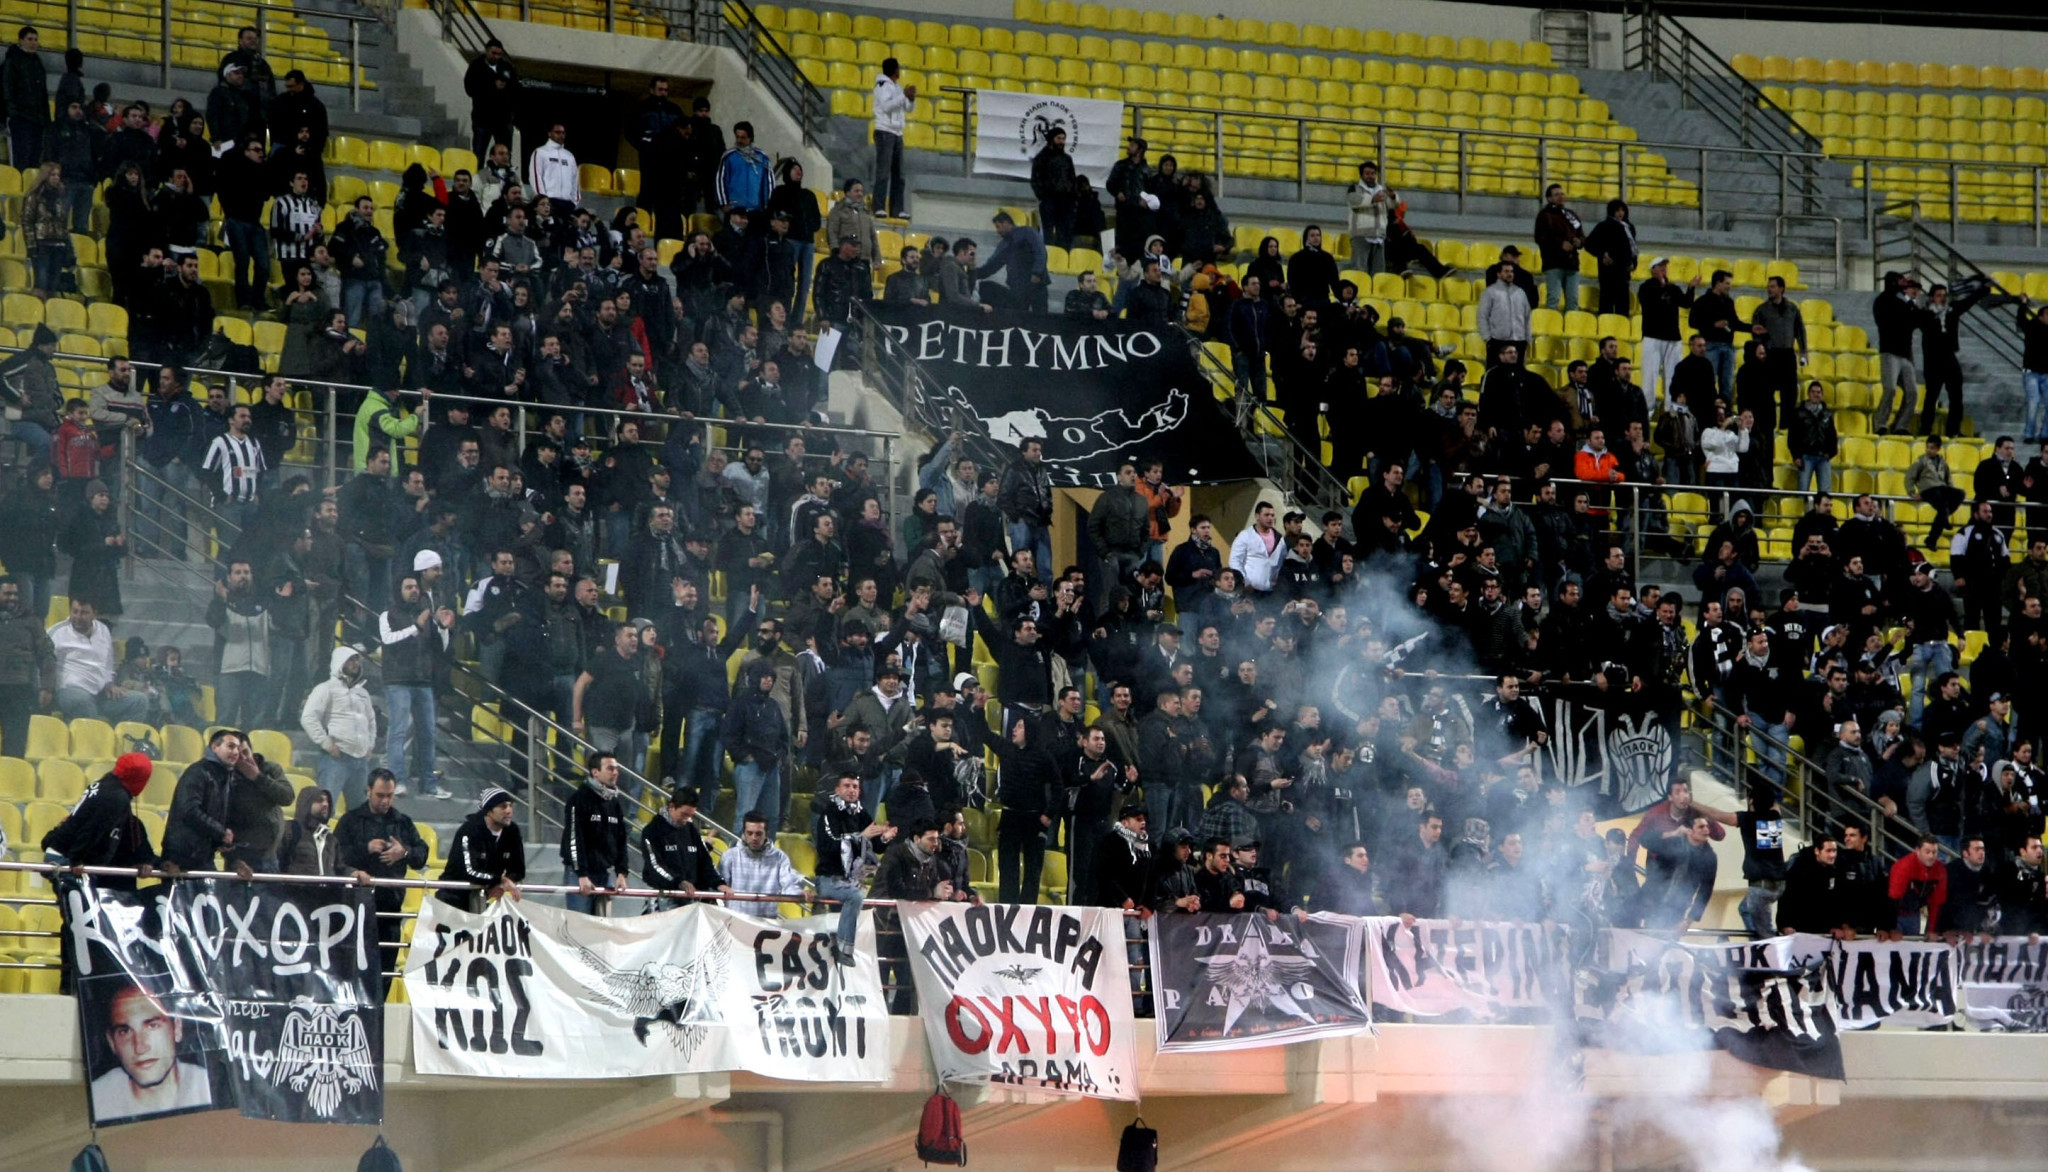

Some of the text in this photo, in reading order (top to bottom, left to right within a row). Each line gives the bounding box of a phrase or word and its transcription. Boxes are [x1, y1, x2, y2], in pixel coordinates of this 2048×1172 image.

[1623, 741, 1655, 756] ΠΑΟΚ
[921, 904, 1104, 991] ΠΑΟΚΑΡΑ
[424, 957, 544, 1056] ΚΩΣ
[945, 994, 1111, 1056] ΟΧΥΡΟ
[303, 1033, 349, 1047] ΠΑΟΚ
